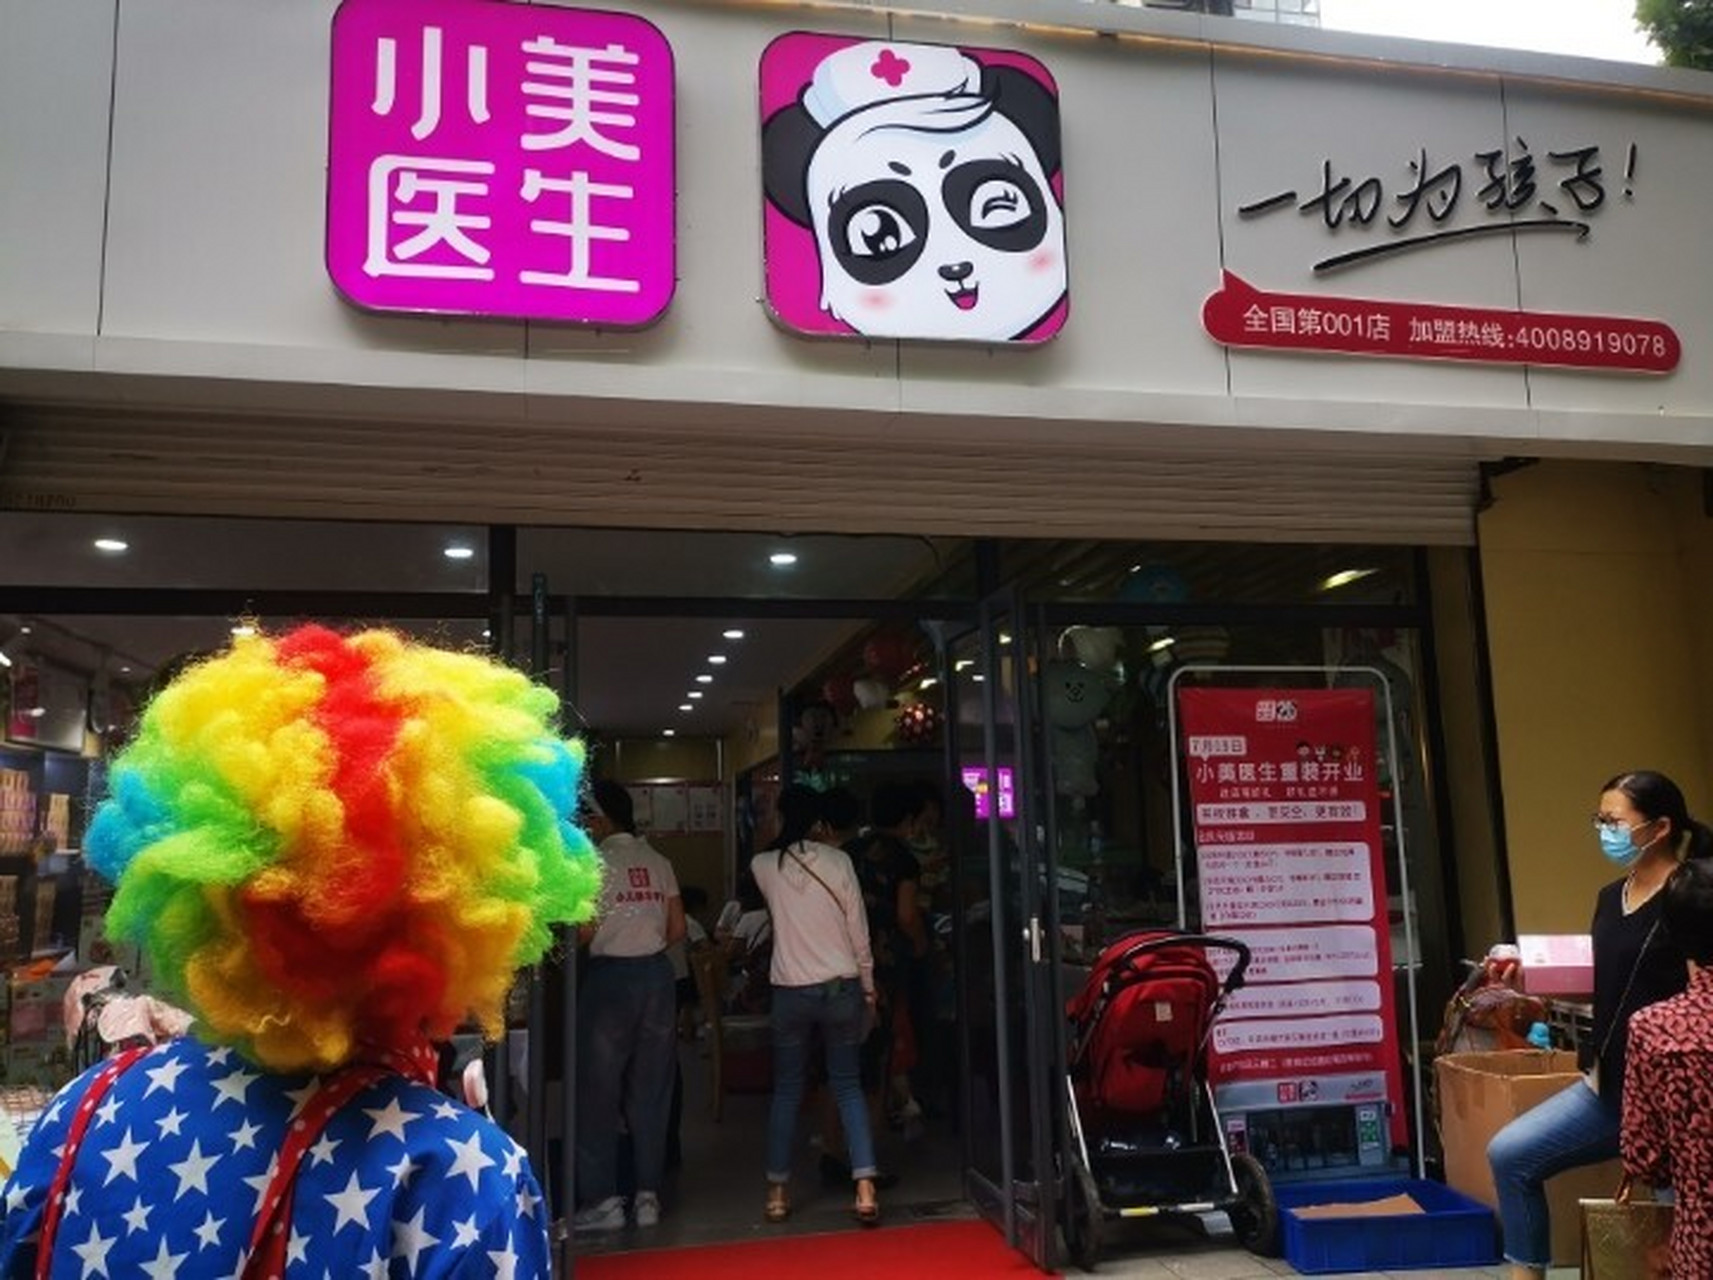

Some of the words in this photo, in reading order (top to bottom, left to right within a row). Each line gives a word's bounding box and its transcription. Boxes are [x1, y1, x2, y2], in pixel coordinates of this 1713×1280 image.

[371, 26, 641, 161] 小美
[362, 154, 641, 293] 医生
[1242, 303, 1391, 342] 全国第001店
[1408, 315, 1667, 358] 加盟热线:4008919078
[1195, 761, 1364, 785] 小美医生重装开业
